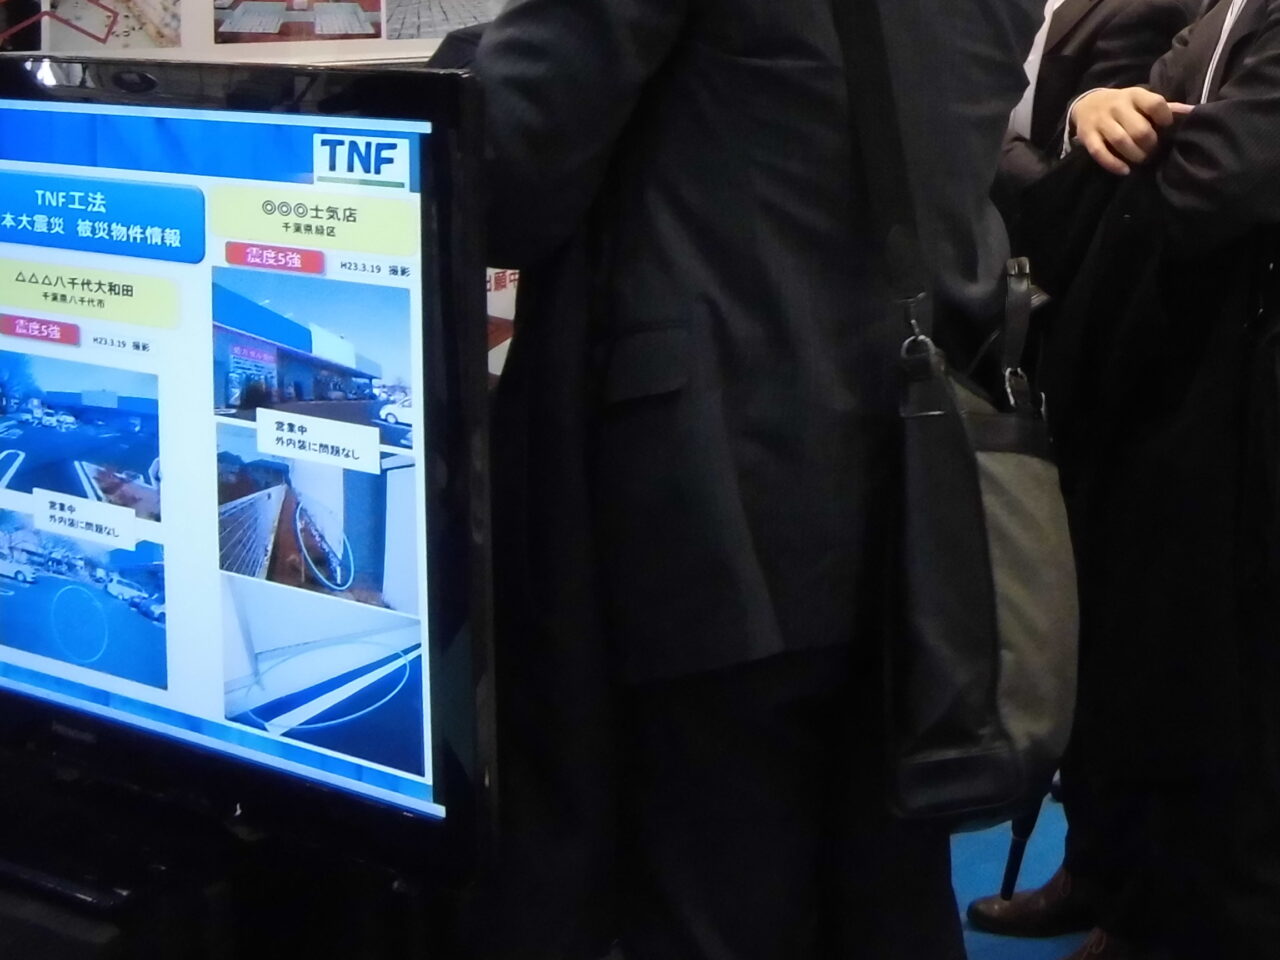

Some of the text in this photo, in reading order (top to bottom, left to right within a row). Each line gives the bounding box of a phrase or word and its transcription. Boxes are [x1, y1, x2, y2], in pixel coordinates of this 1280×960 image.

[320, 138, 398, 176] TNF
[34, 189, 107, 214] TNF工法
[75, 217, 183, 249] 被災物件情報
[245, 247, 303, 269] 震度5強
[274, 420, 309, 436] 営業中
